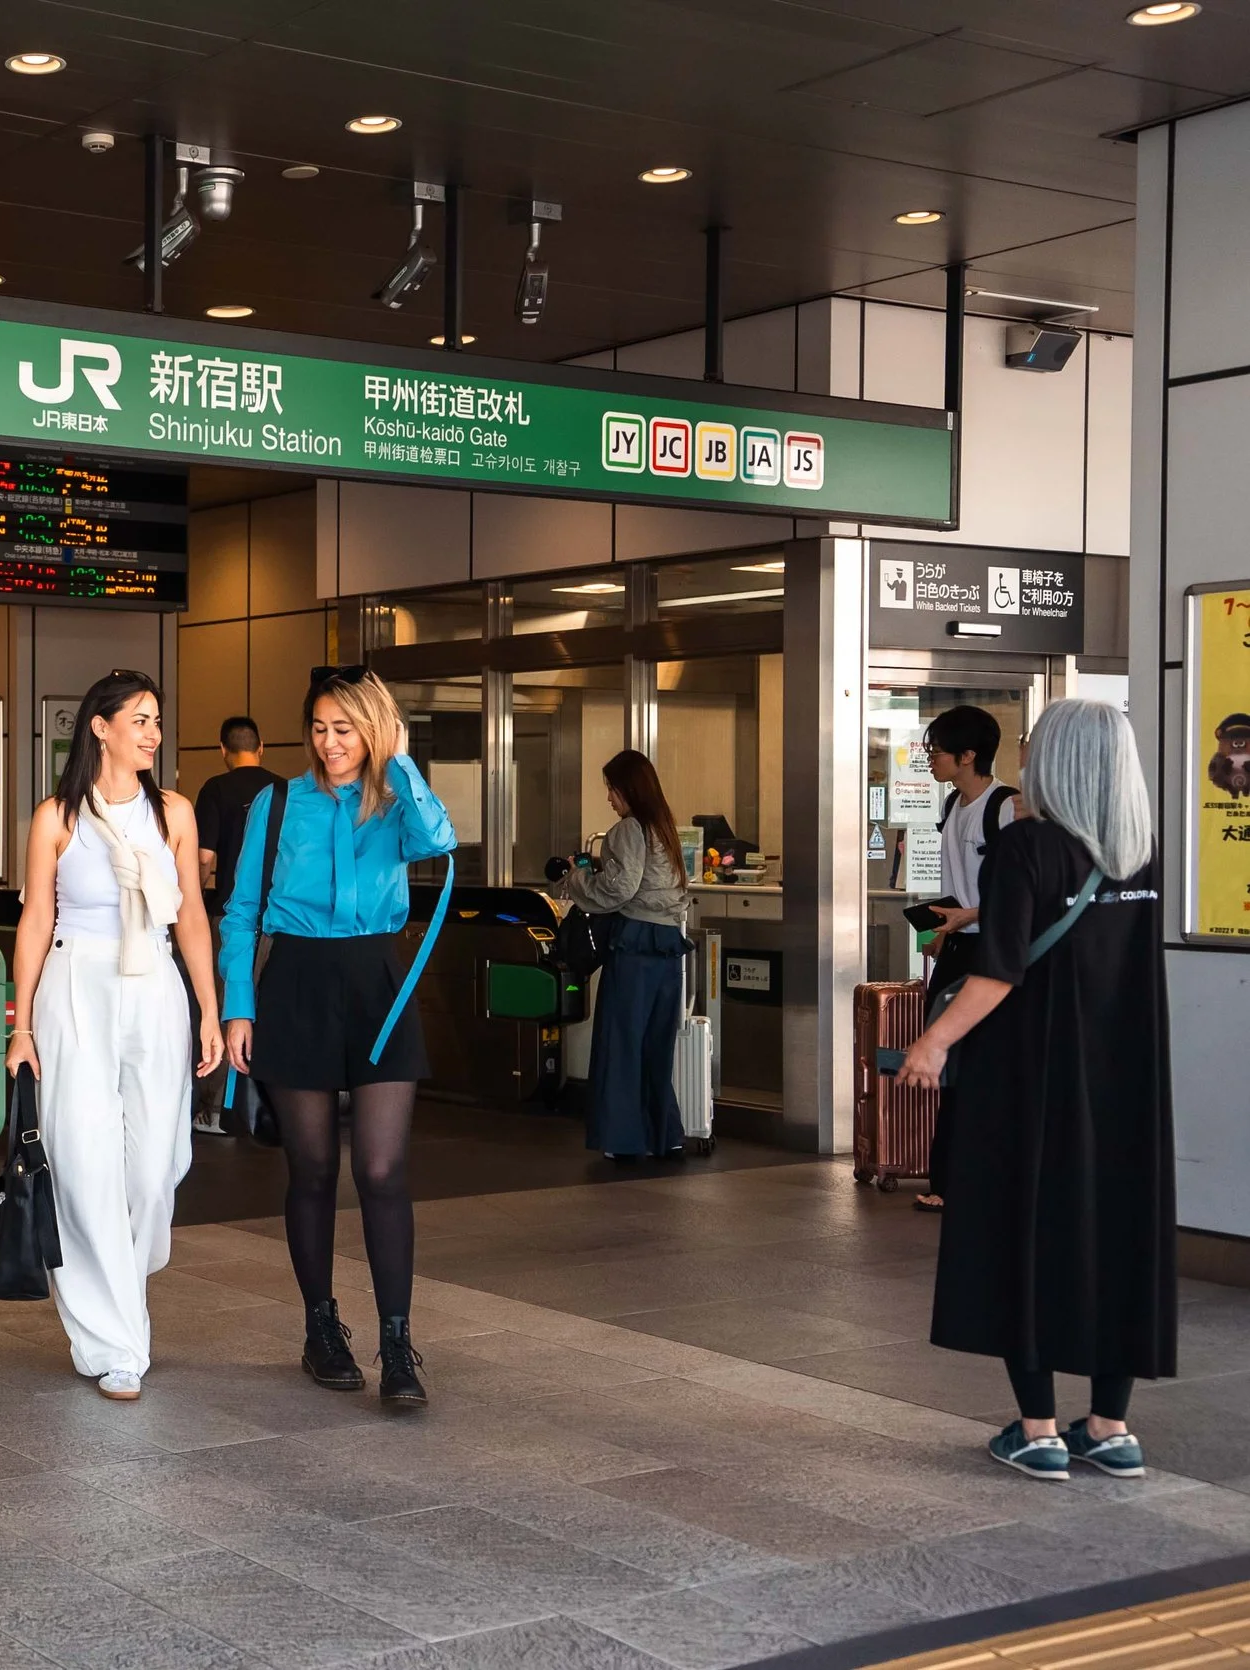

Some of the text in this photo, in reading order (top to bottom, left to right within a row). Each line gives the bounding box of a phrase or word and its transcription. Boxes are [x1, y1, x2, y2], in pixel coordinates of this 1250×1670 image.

[19, 338, 122, 410] JR
[149, 350, 284, 415] 新宿駅
[364, 375, 530, 426] 甲州街道改札
[33, 410, 108, 433] JR東日本
[149, 412, 342, 456] Shinjuku Station
[364, 416, 508, 448] Kōshū-kaidō Gate
[364, 441, 581, 477] 甲州街道检票口 고슈카이도 개찰구
[612, 431, 813, 472] JY JC JB JA JS
[916, 562, 946, 579] うらが
[1022, 569, 1064, 587] 車椅子を
[916, 583, 980, 600] 白色のきっぷ
[1022, 590, 1074, 607] ご利用の方
[916, 601, 981, 613] White Backed Tickets
[1022, 607, 1068, 618] for Wheelchair
